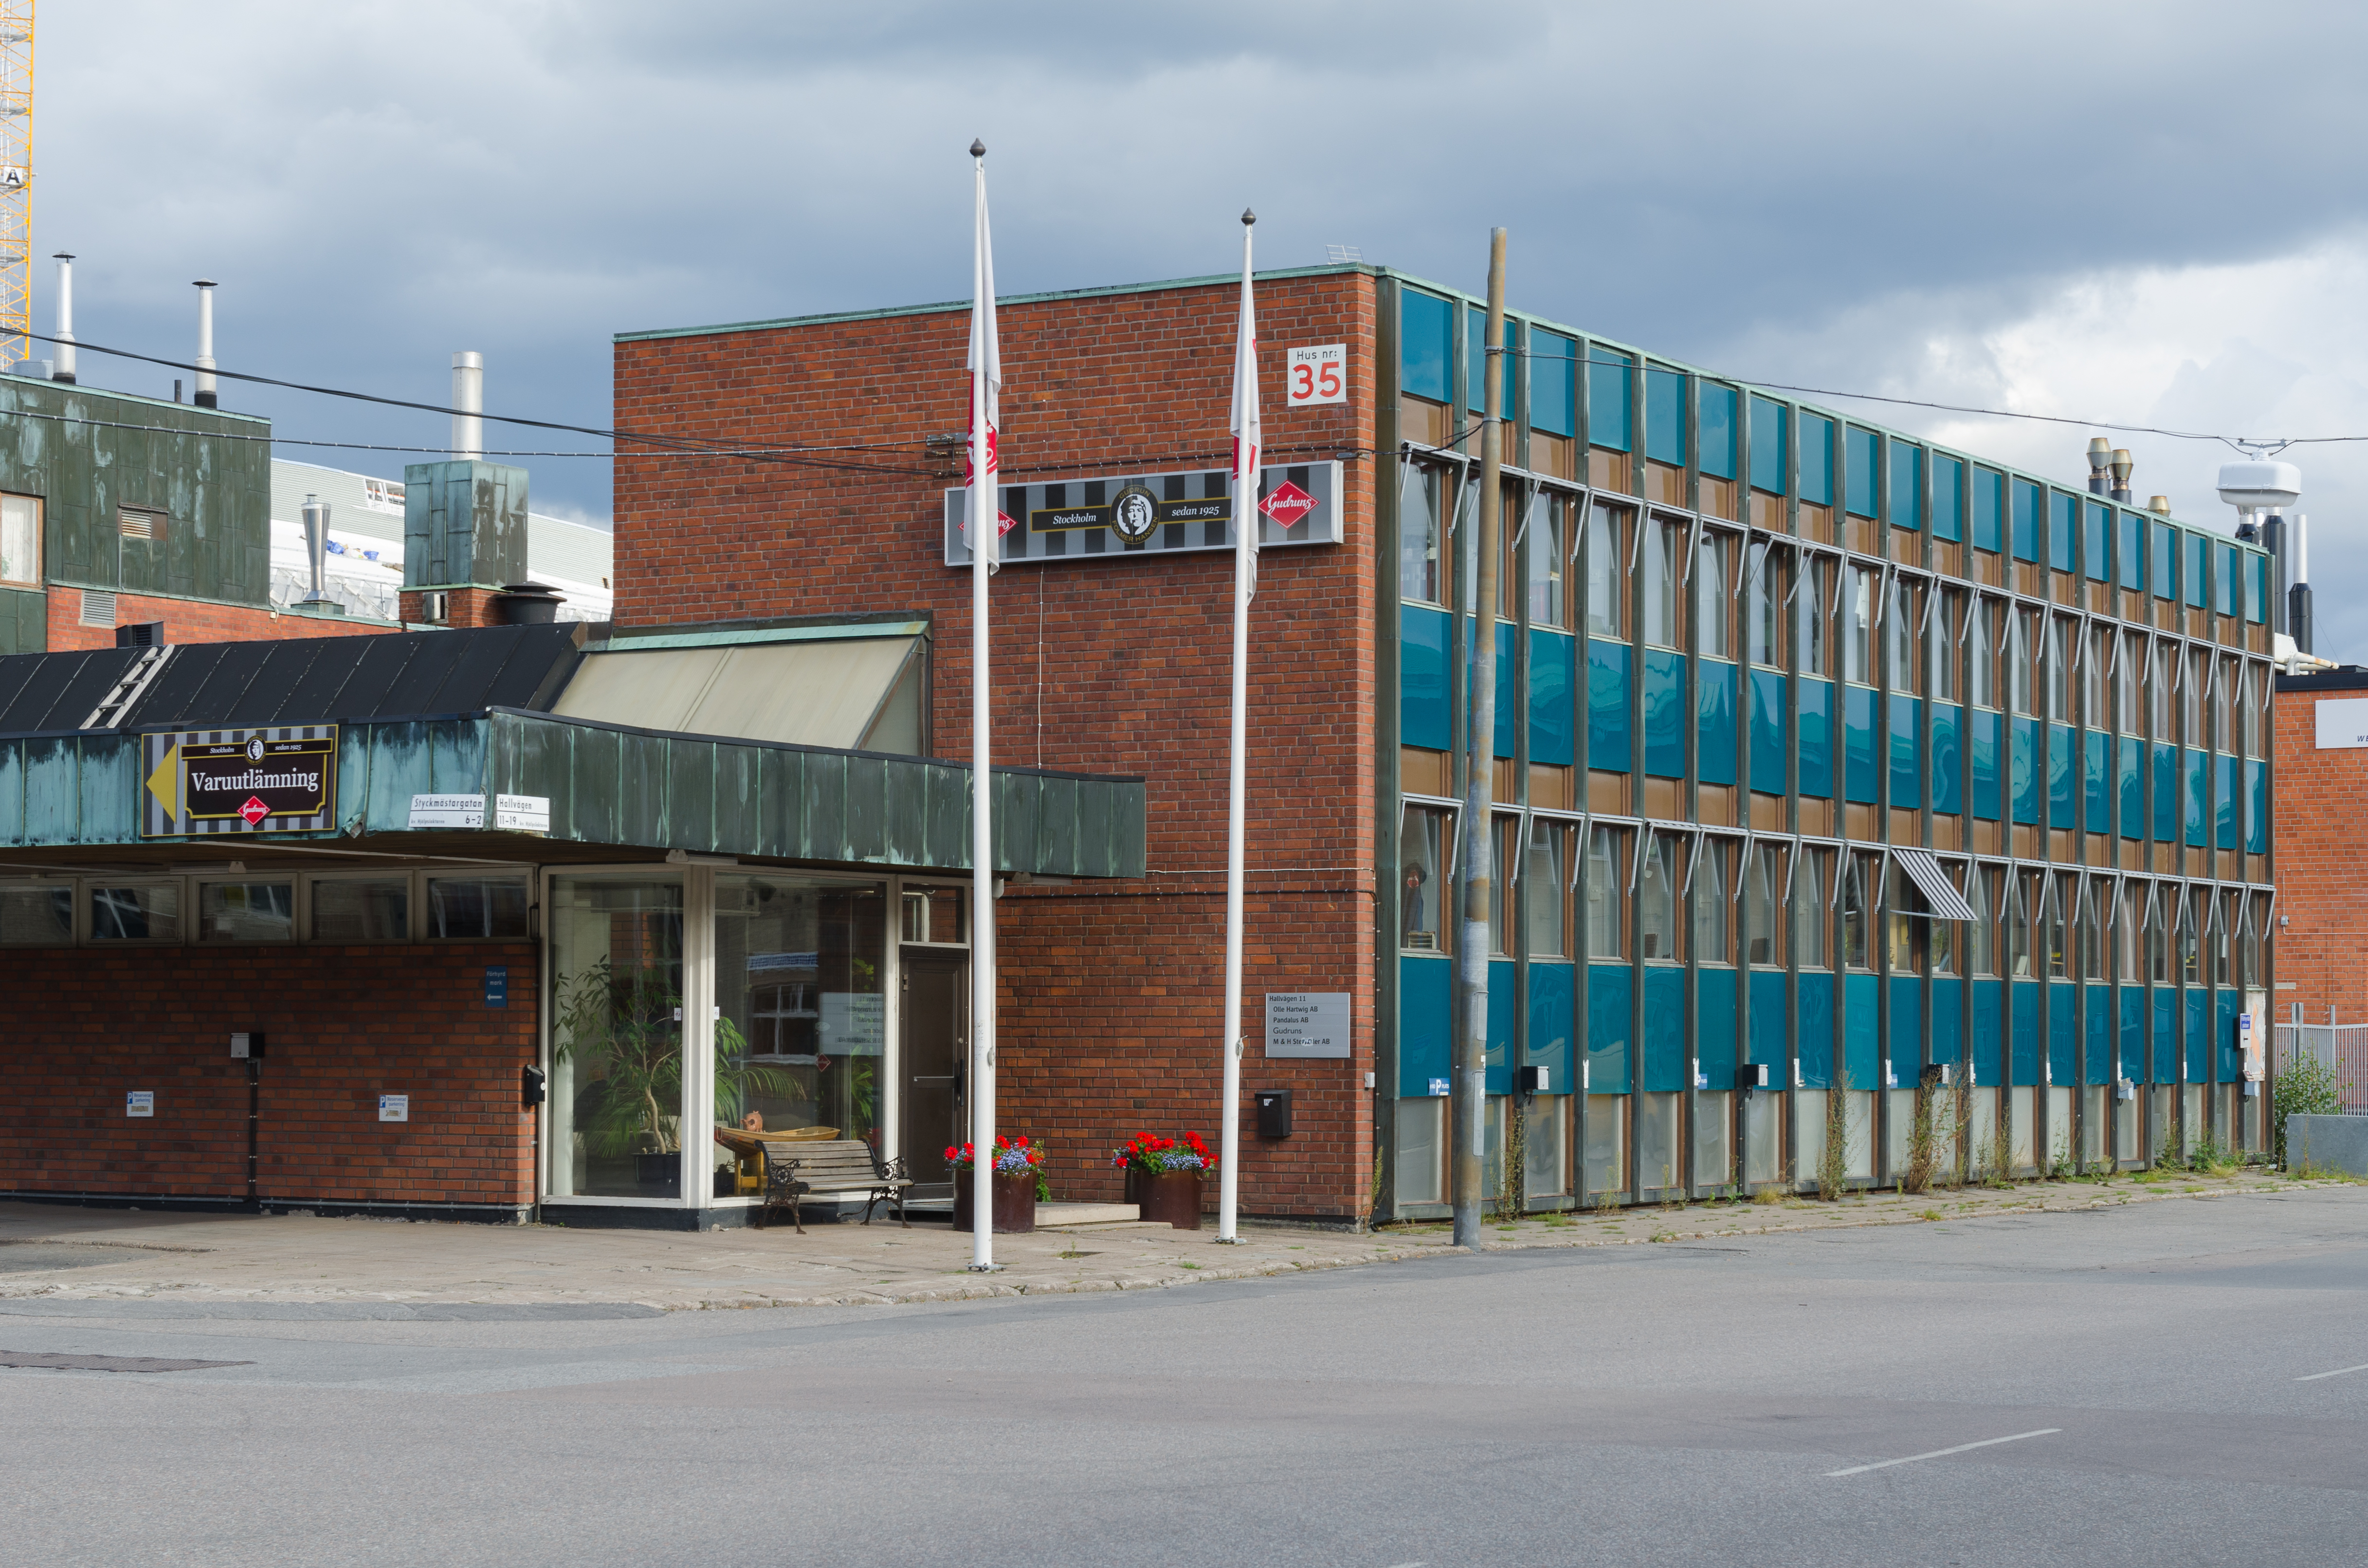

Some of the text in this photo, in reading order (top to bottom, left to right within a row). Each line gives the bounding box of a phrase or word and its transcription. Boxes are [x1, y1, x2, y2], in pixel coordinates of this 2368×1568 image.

[6, 169, 19, 183] A
[1297, 350, 1337, 360] Hus nr:
[1292, 361, 1341, 400] 35
[1119, 487, 1150, 499] GUDRUN
[1171, 506, 1220, 516] sedan 1925
[1267, 493, 1312, 516] Gudruns
[1053, 512, 1096, 524] Stockholm
[1112, 516, 1158, 542] FOLMER HANSEN
[191, 767, 319, 792] Varuutlämning
[415, 797, 482, 810] Styckmästargatan
[499, 798, 532, 811] Hallvägen
[1436, 1079, 1442, 1094] P
[128, 1093, 132, 1103] P
[380, 1096, 385, 1107] P
